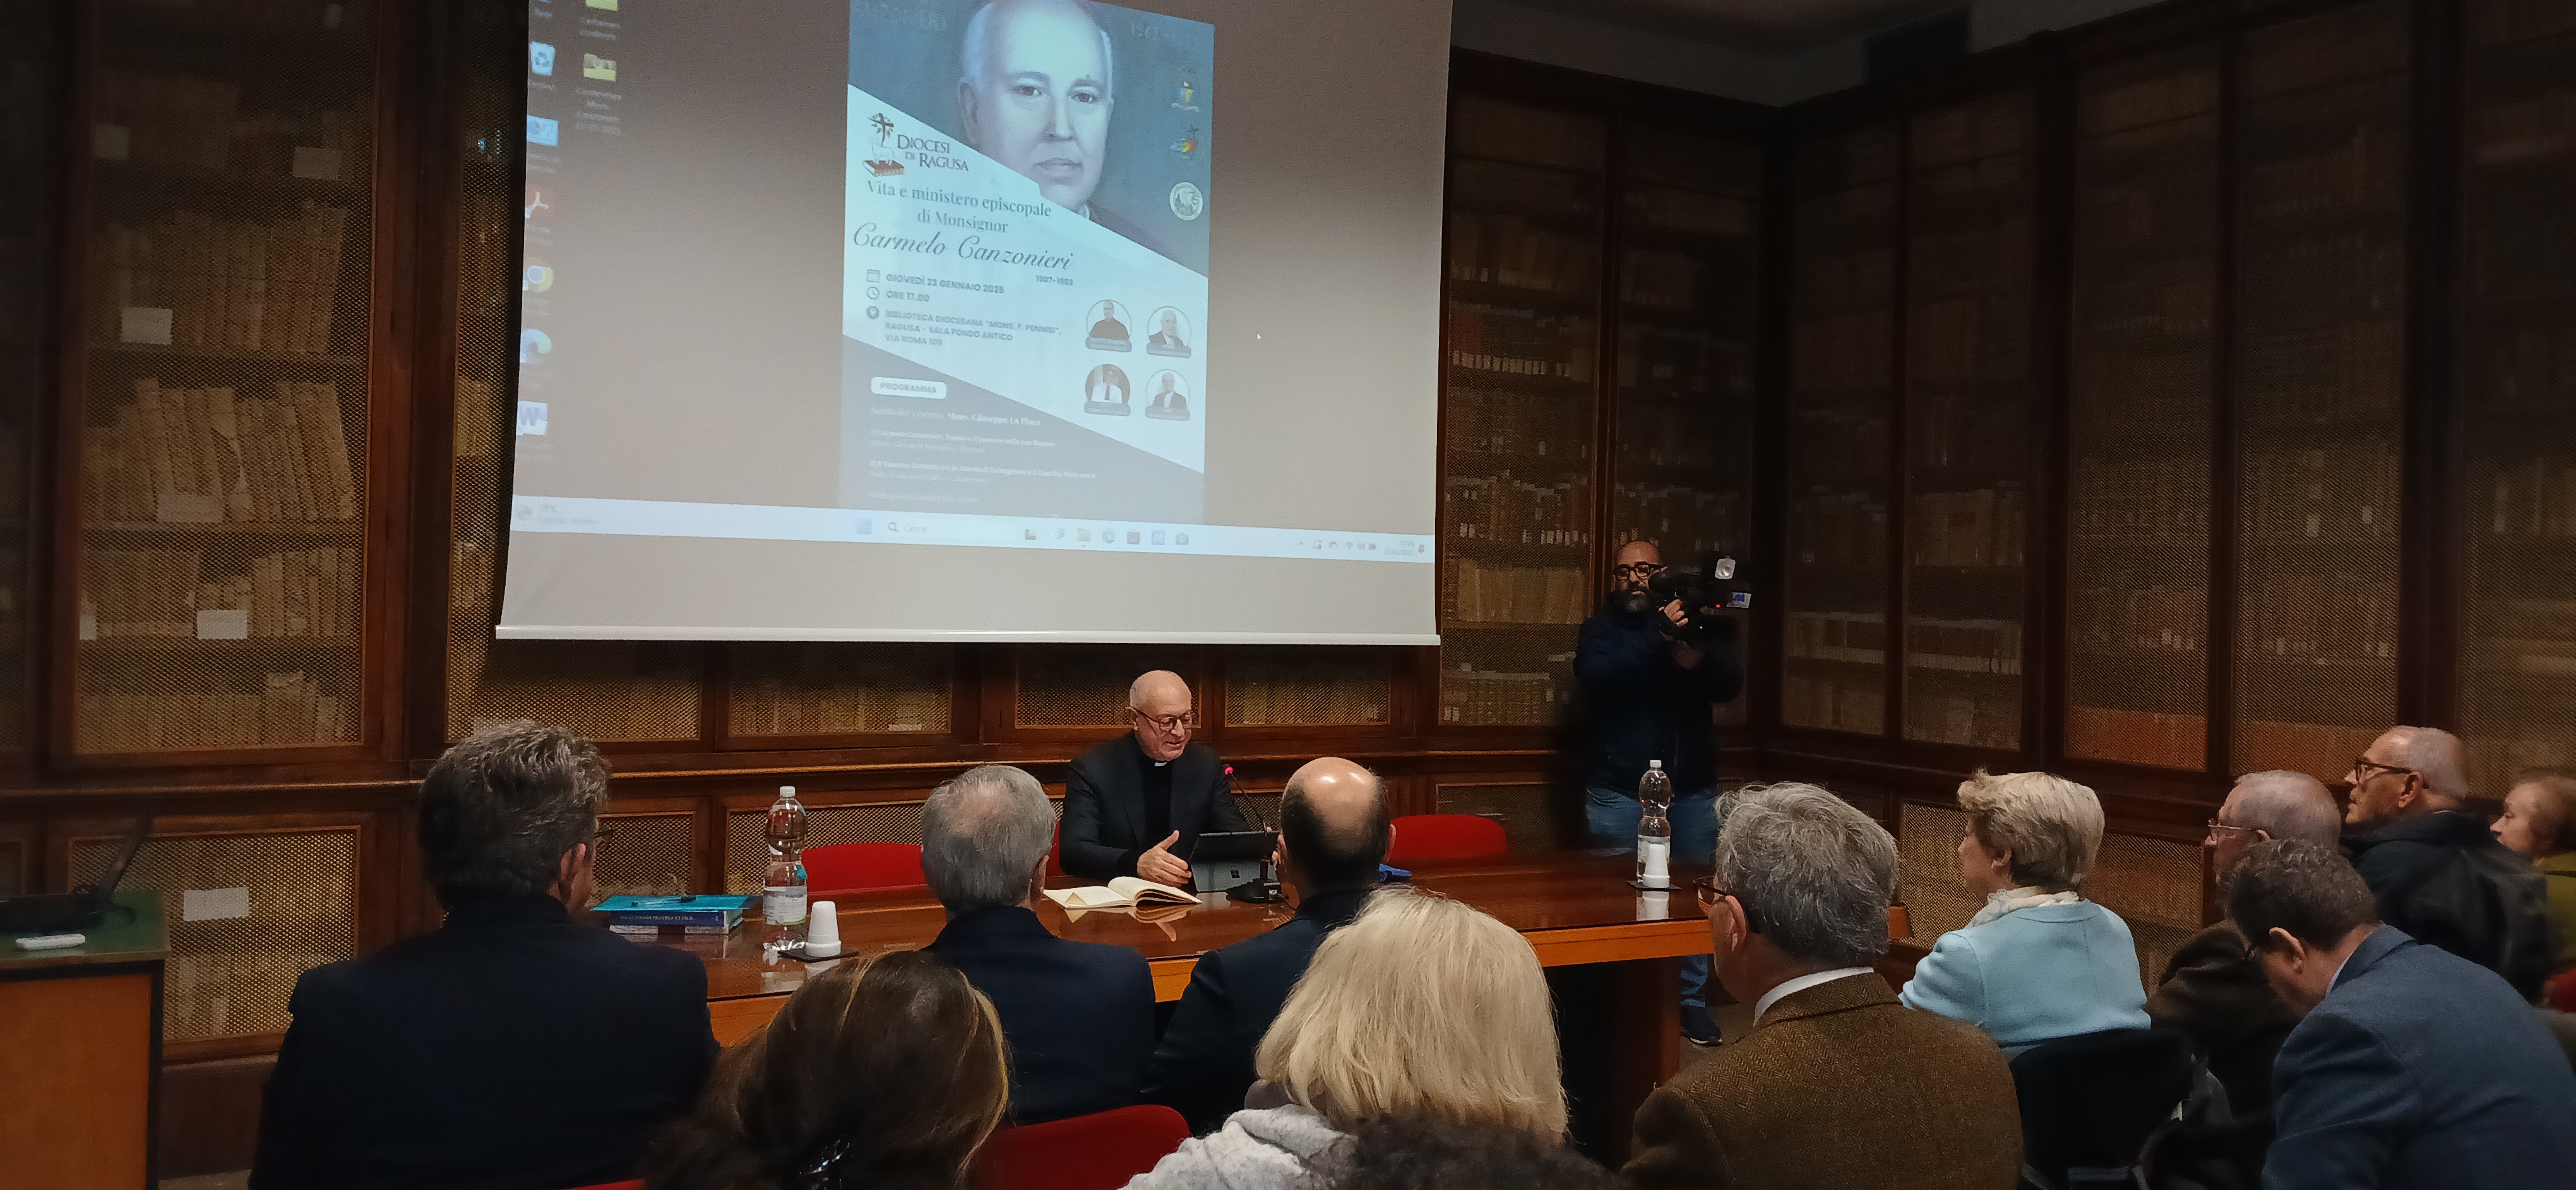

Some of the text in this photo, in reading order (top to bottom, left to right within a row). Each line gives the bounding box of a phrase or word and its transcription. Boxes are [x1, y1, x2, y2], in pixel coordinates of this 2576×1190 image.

[897, 134, 950, 153] DIOCESI
[919, 152, 969, 171] RAGUSA
[868, 180, 1052, 217] Vita e ministero episcopale
[917, 209, 1008, 232] di Monsignor
[854, 222, 1074, 270] Carmelo Canzonieri
[939, 279, 981, 291] GENNAIO
[886, 291, 904, 300] ORE
[885, 310, 934, 322] BIBLIOTECA
[936, 315, 984, 326] DIOCESANA
[885, 322, 921, 332] RAGUSA
[929, 325, 949, 335] SALA
[951, 328, 980, 338] FONDO
[982, 331, 1013, 340] ANTICO
[902, 335, 927, 344] ROMA
[880, 382, 937, 393] PROGRAMMA
